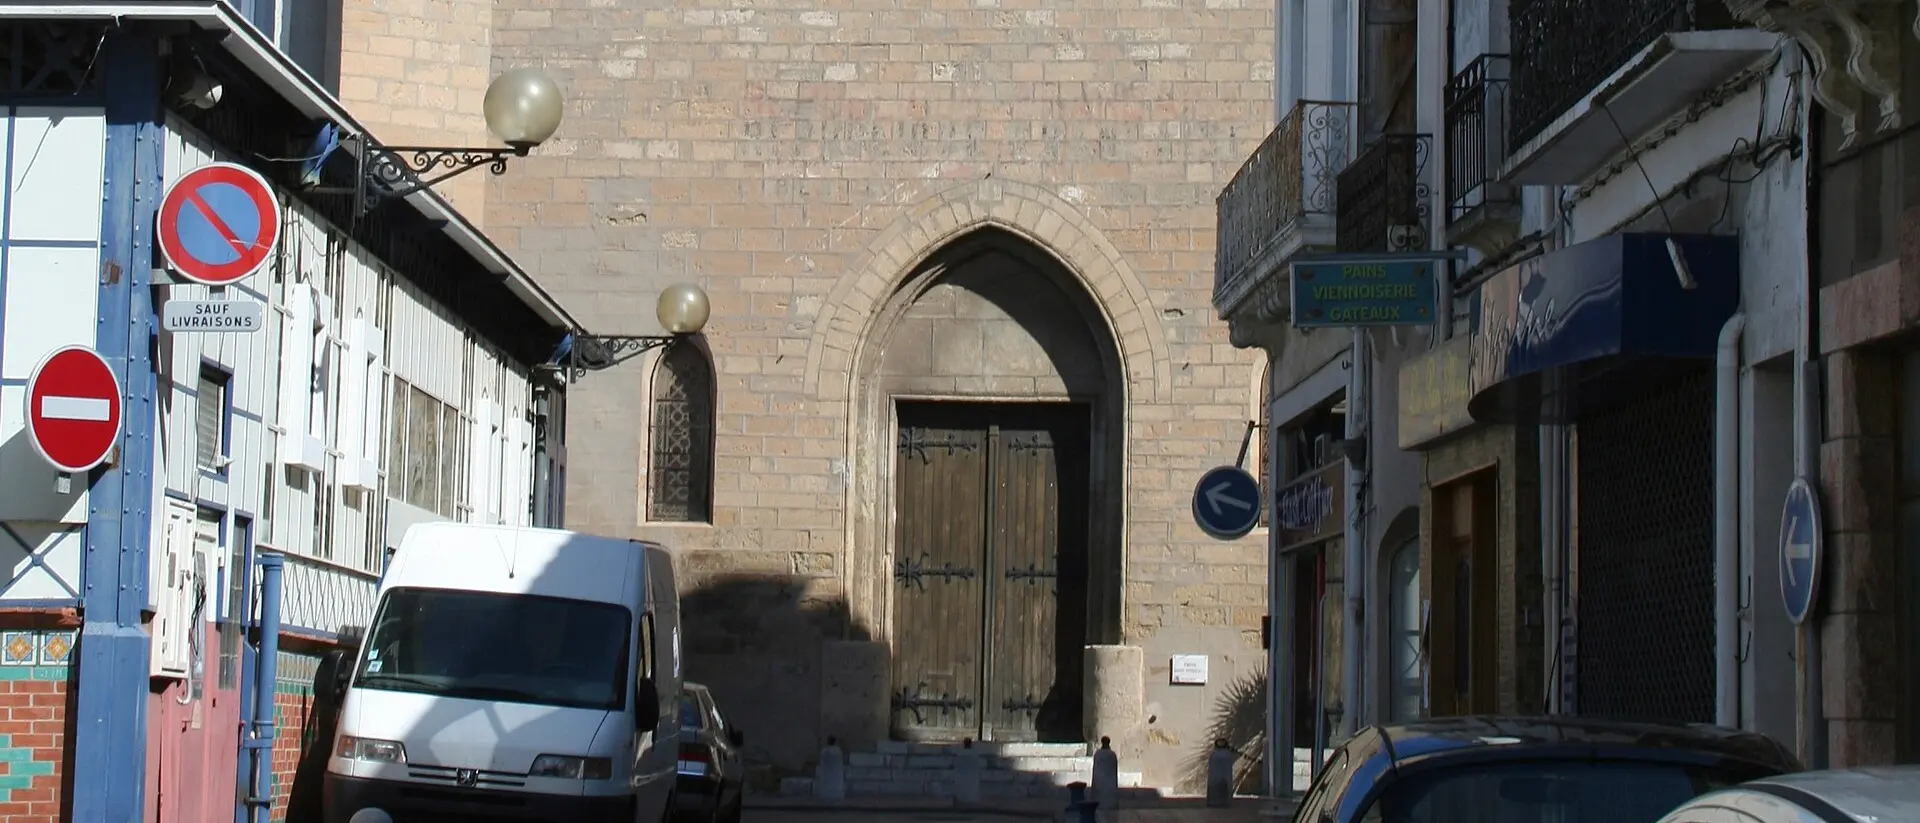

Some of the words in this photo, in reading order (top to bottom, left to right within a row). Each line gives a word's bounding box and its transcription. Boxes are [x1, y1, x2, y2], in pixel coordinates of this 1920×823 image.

[1342, 264, 1387, 279] PAINS
[1313, 284, 1418, 300] VIENNOISERIE
[195, 303, 230, 315] SAUF
[1330, 305, 1400, 321] GATEAUX
[171, 316, 252, 327] LIVRAISONS
